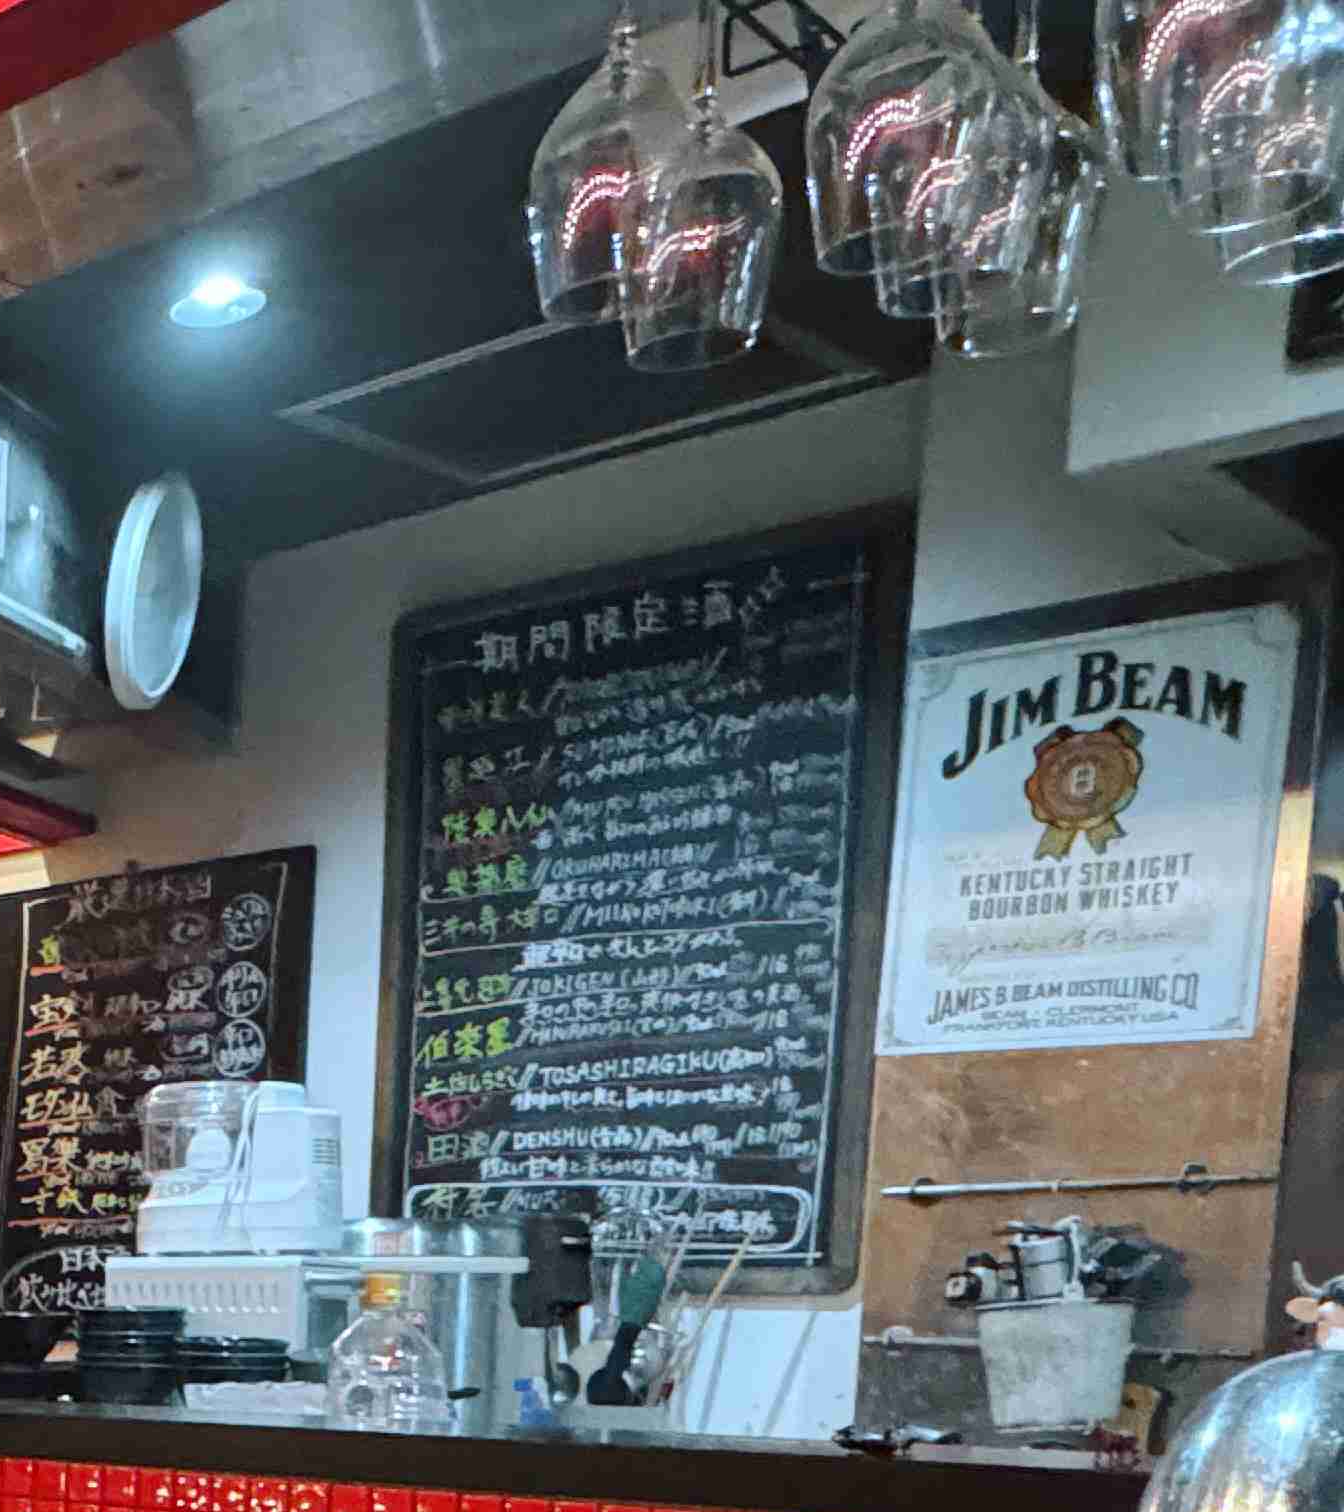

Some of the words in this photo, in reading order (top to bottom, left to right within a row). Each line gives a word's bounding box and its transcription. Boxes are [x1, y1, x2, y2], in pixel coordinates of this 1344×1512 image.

[942, 674, 1062, 780] JIM
[1071, 650, 1248, 743] BEAM
[960, 865, 1073, 897] KENTUCKY
[1078, 852, 1194, 886] STRAIGHT
[968, 889, 1069, 922] BOURBON
[1078, 880, 1181, 912] WHISKEY
[927, 985, 992, 1025] JAMES
[1010, 980, 1064, 1004] BEAM
[1065, 973, 1169, 1004] DISTILLING
